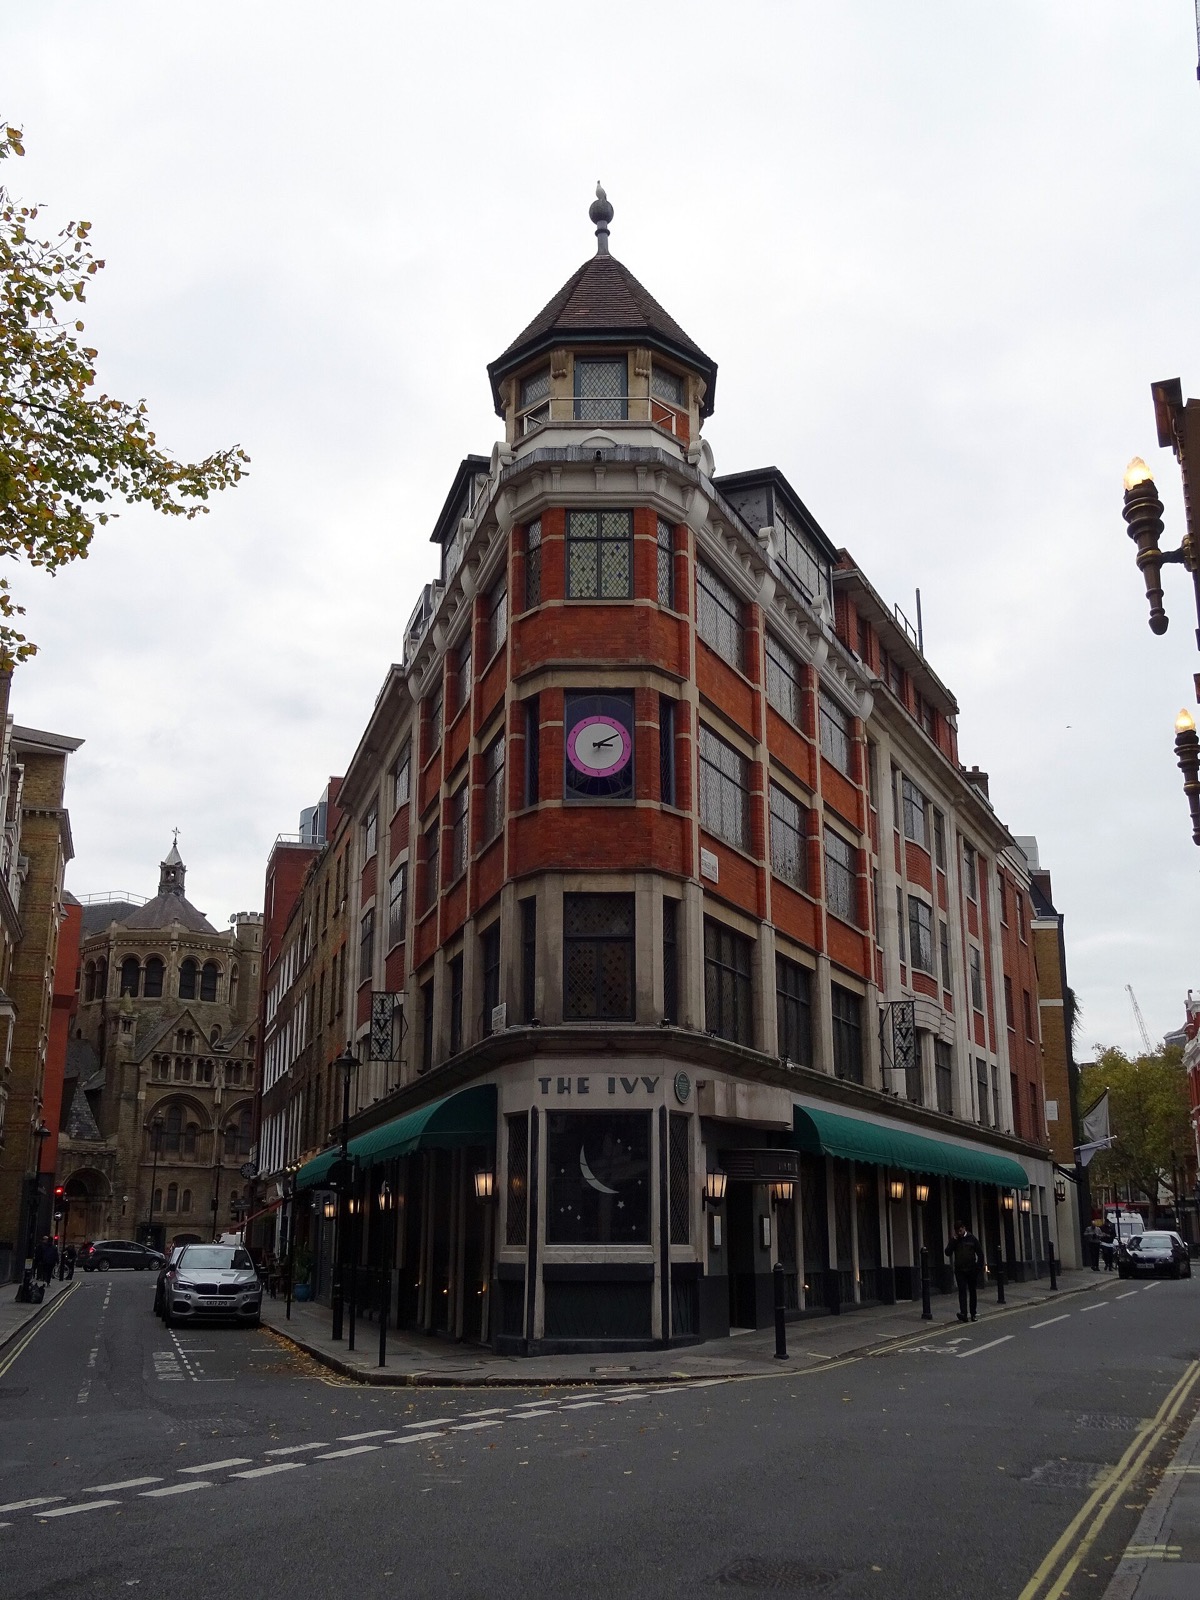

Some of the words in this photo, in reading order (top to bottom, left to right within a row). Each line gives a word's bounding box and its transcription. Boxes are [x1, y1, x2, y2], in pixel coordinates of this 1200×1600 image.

[373, 998, 391, 1054] IVY
[895, 1007, 914, 1062] IVY
[538, 1076, 590, 1094] THE
[607, 1076, 660, 1094] IVY
